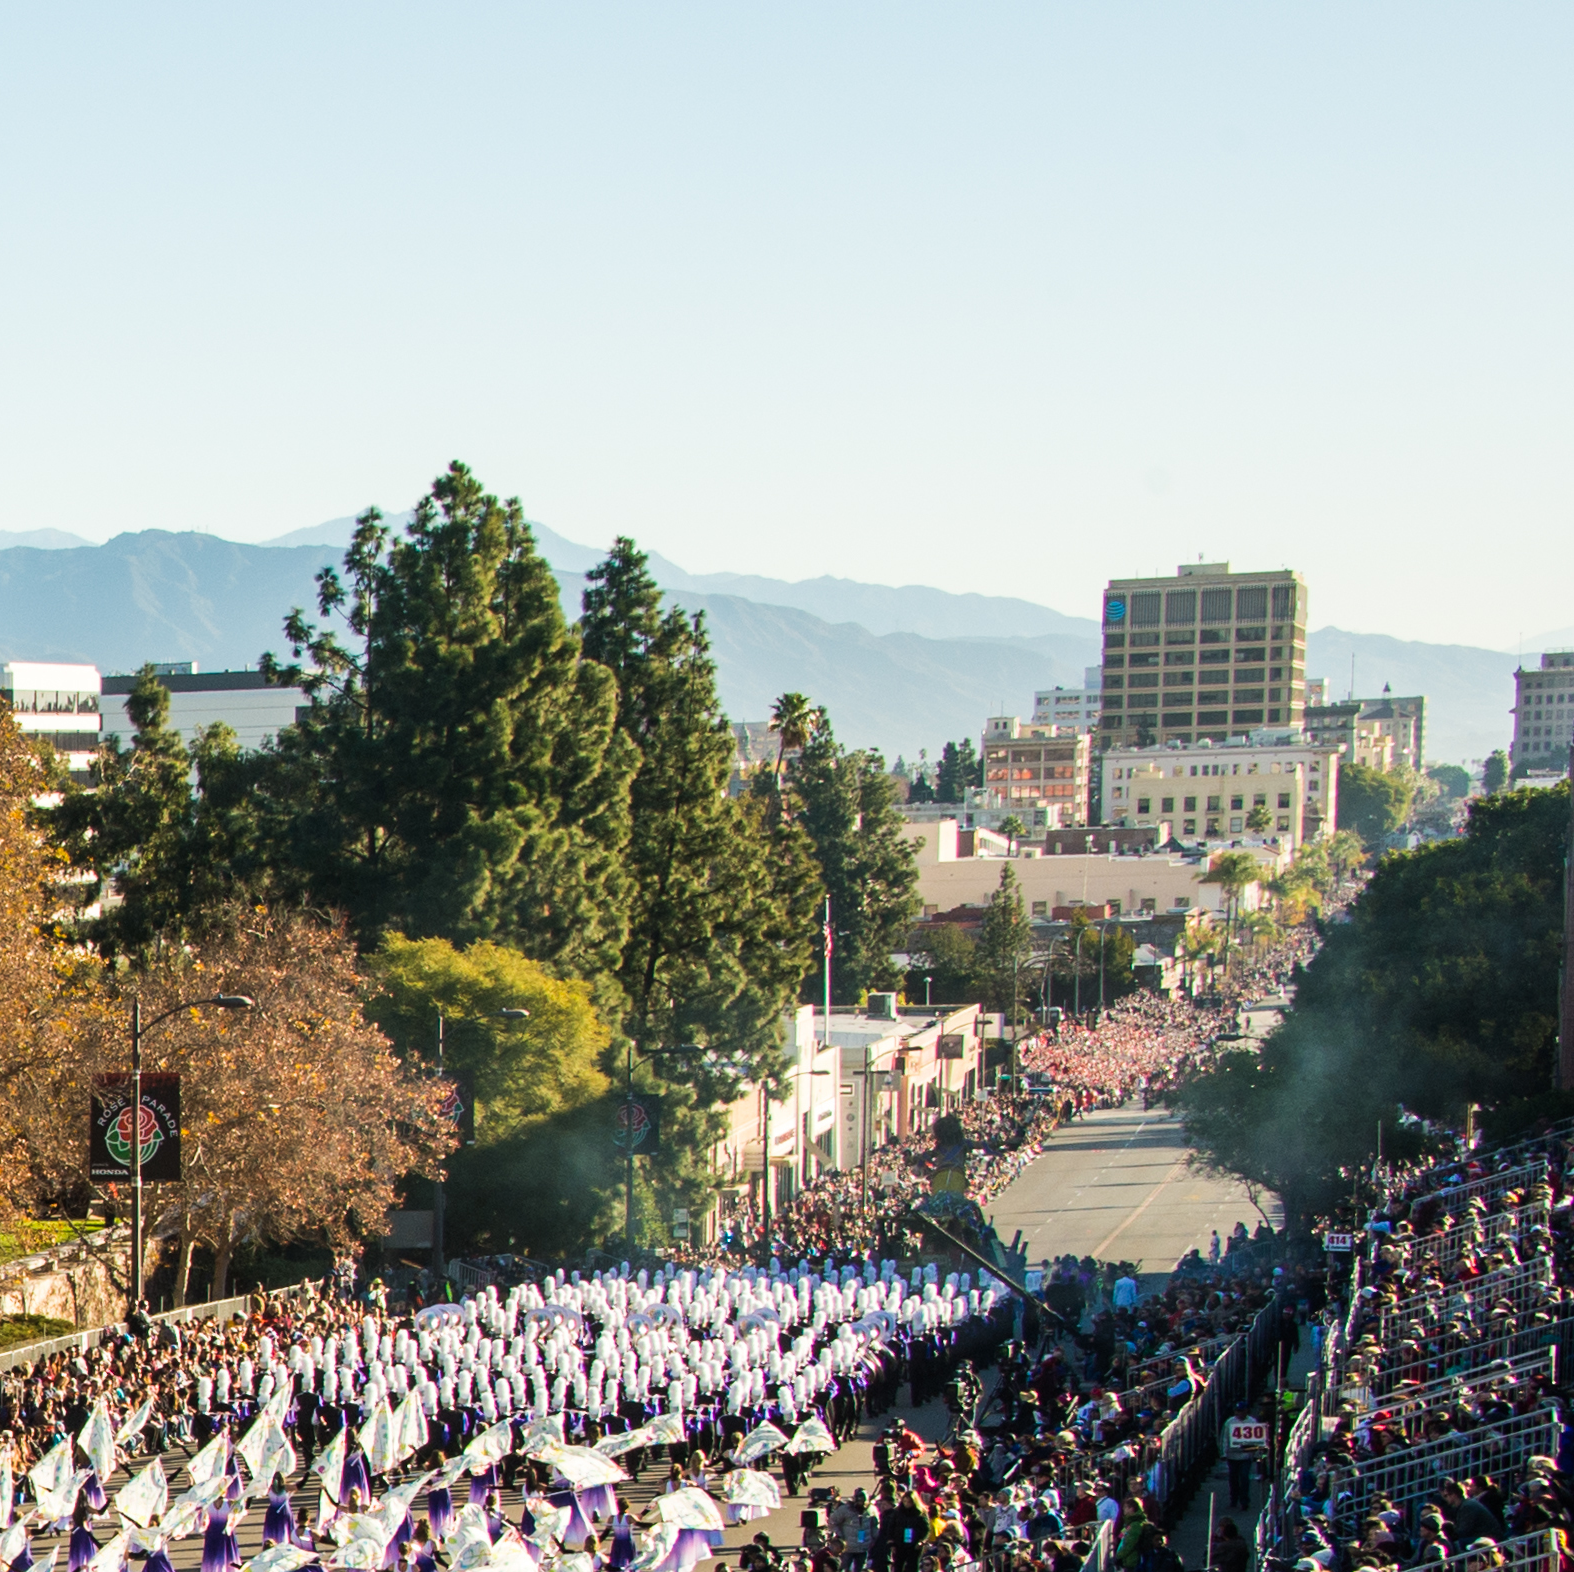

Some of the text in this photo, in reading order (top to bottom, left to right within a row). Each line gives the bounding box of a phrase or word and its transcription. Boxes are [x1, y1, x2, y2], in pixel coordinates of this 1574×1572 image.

[97, 1095, 178, 1138] ROSE PARADE
[91, 1168, 129, 1176] HONDA
[1232, 1426, 1263, 1439] 430
